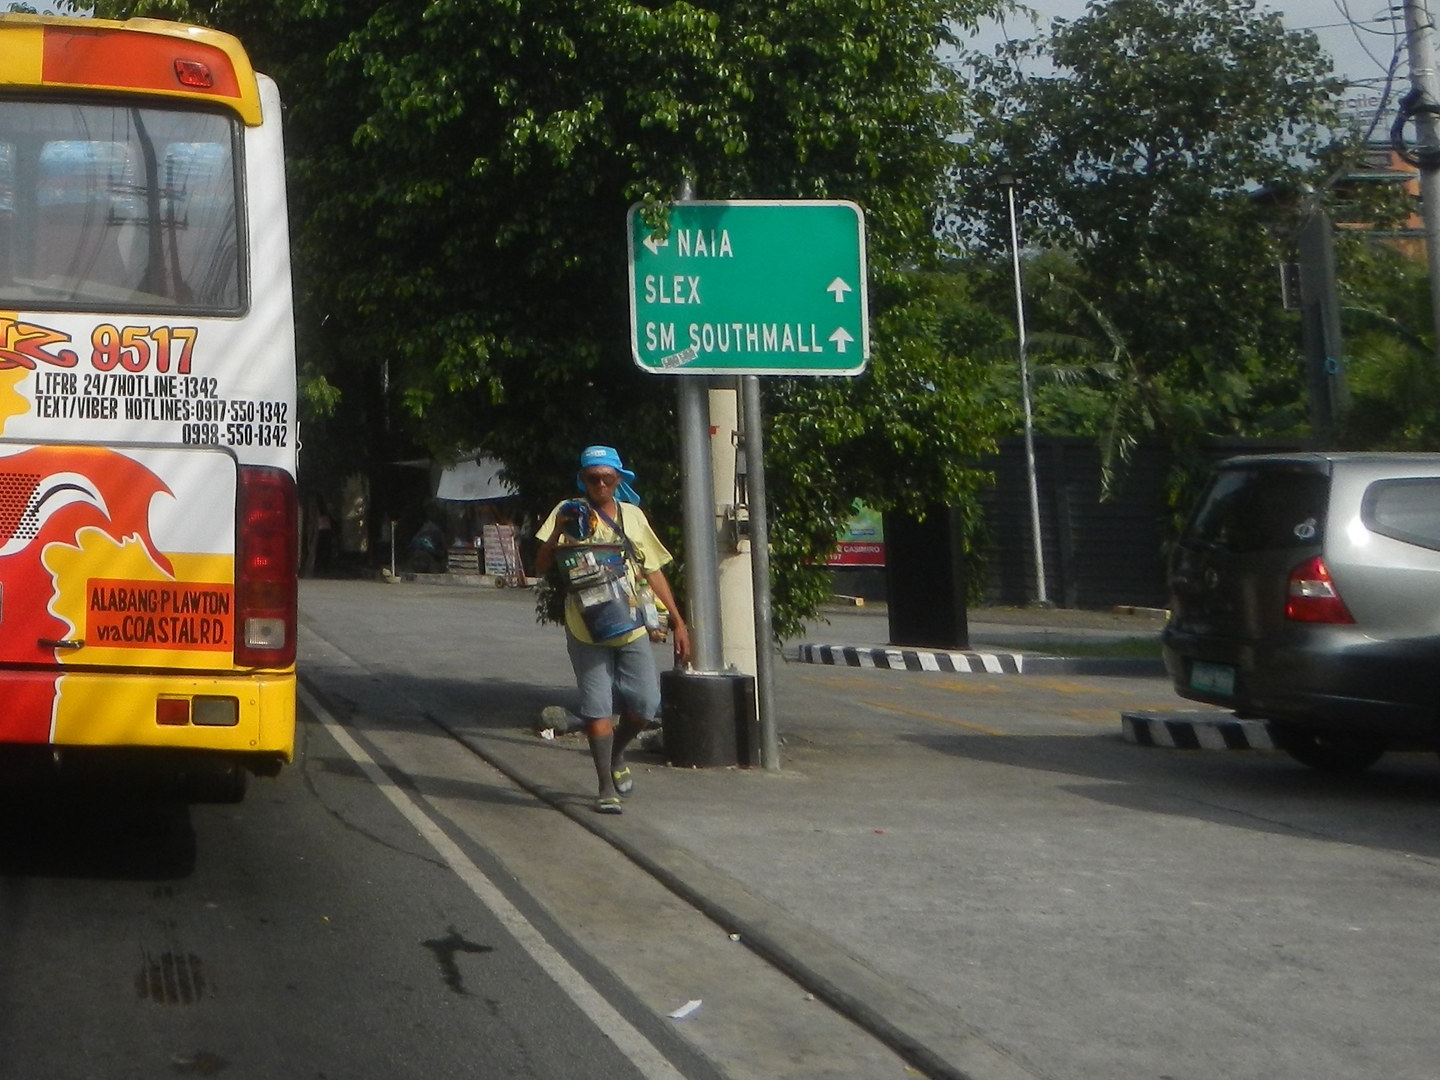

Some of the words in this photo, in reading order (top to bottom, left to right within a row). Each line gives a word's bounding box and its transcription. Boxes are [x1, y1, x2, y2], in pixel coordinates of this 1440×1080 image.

[677, 229, 733, 257] NAIA
[645, 275, 701, 304] SLEX
[91, 323, 198, 374] 9517
[645, 322, 675, 351] SM
[688, 323, 823, 352] SOUTHMALL
[35, 372, 77, 395] LTFRB
[35, 396, 118, 420] TEXT/VIBER
[182, 423, 288, 447] 0998-550-1342
